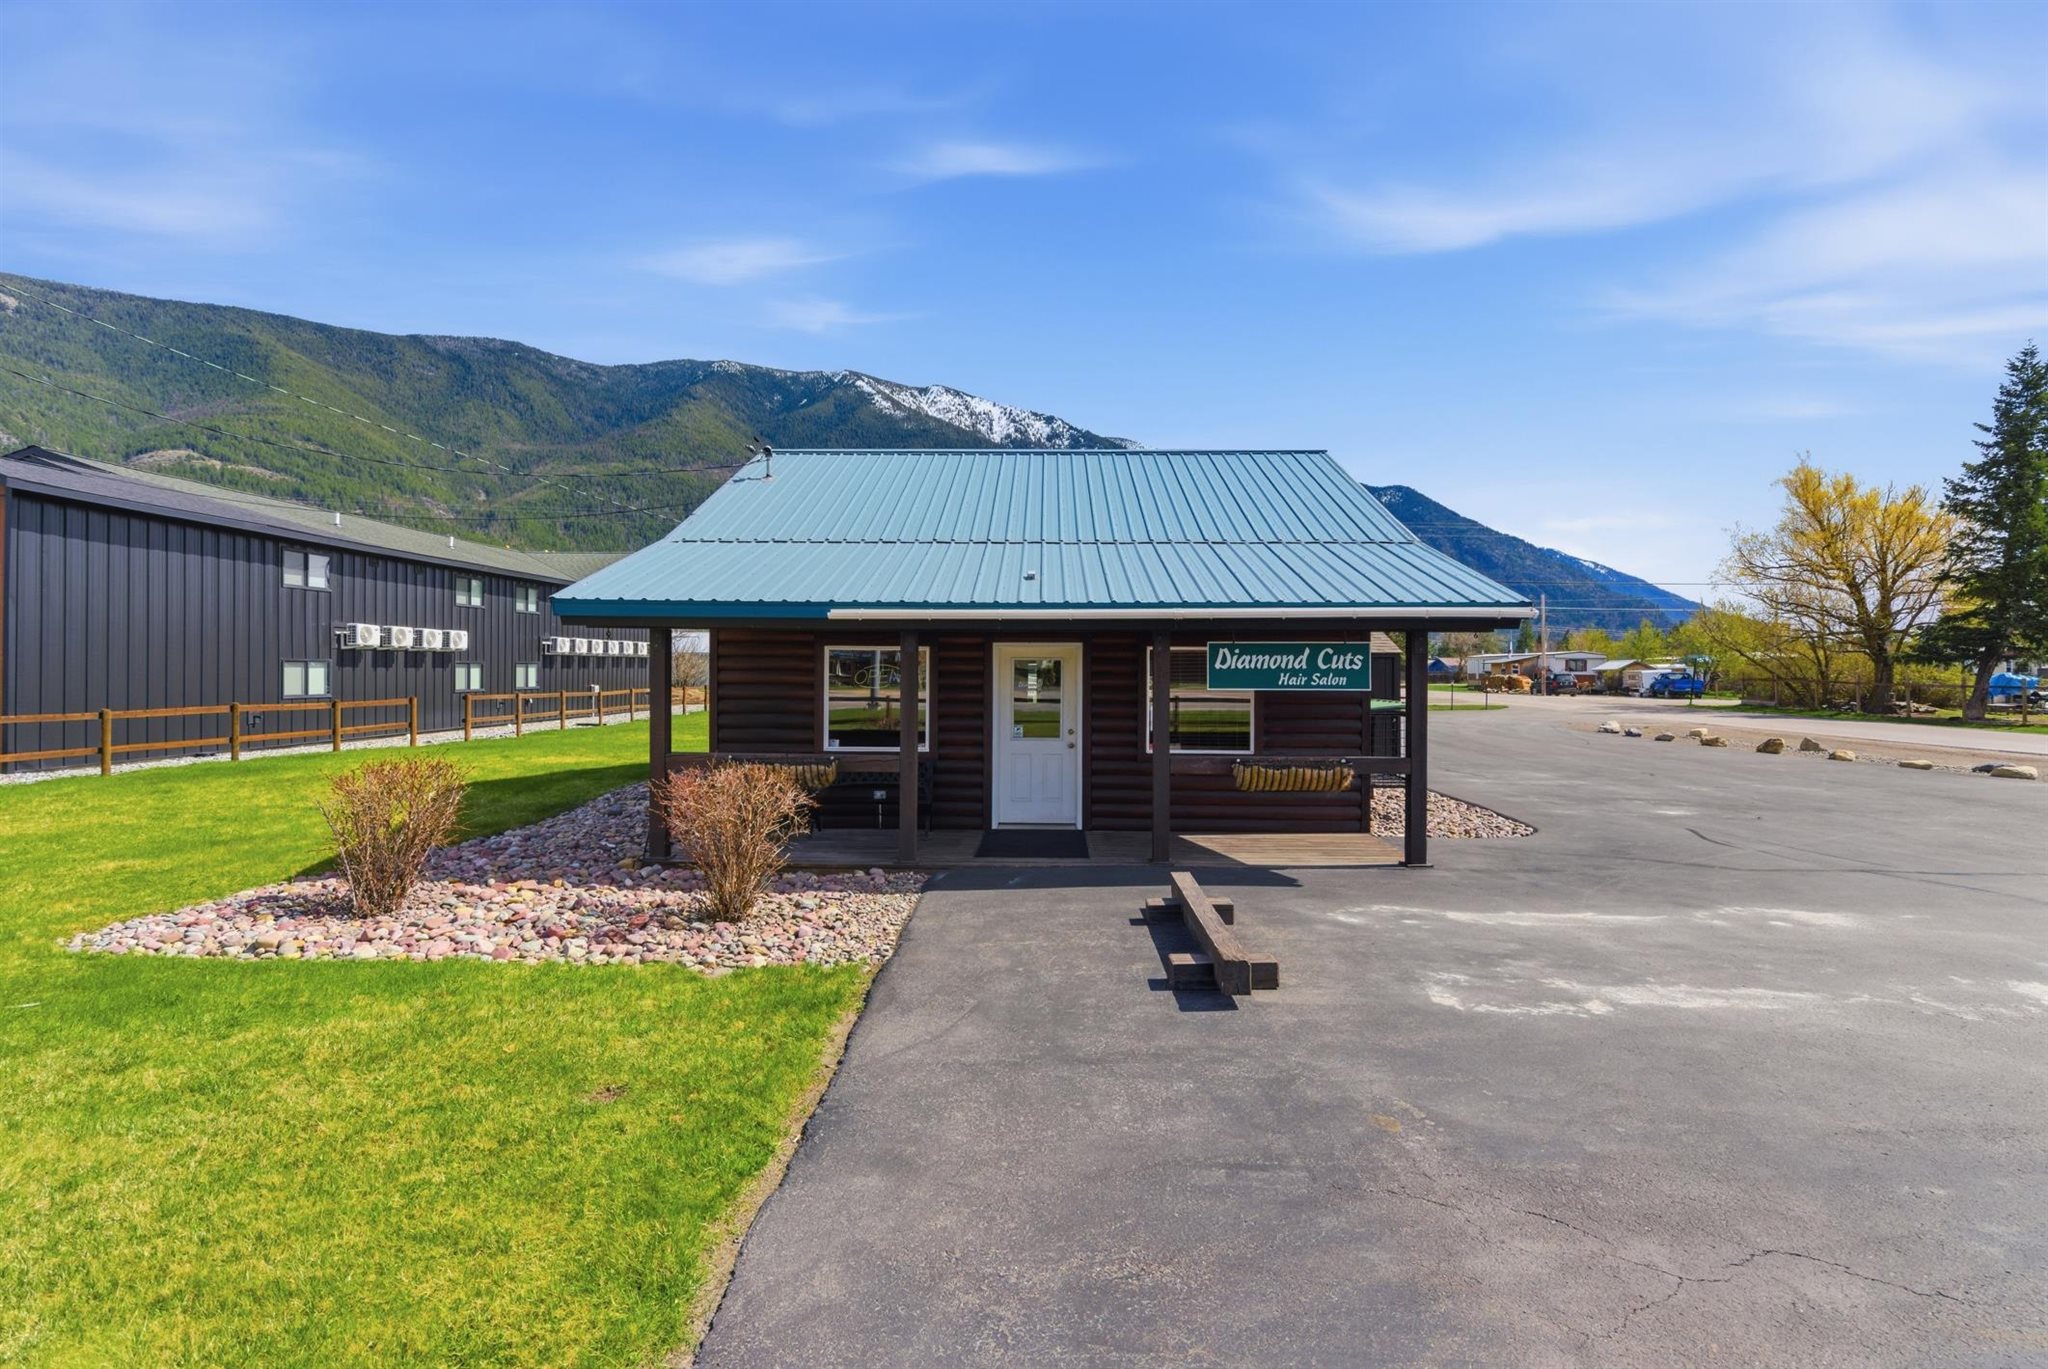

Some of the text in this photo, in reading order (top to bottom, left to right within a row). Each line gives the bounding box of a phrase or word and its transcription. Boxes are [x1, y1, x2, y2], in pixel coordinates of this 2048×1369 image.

[1215, 647, 1364, 670] Diamond Cuts
[1278, 672, 1347, 686] Hair Salon
